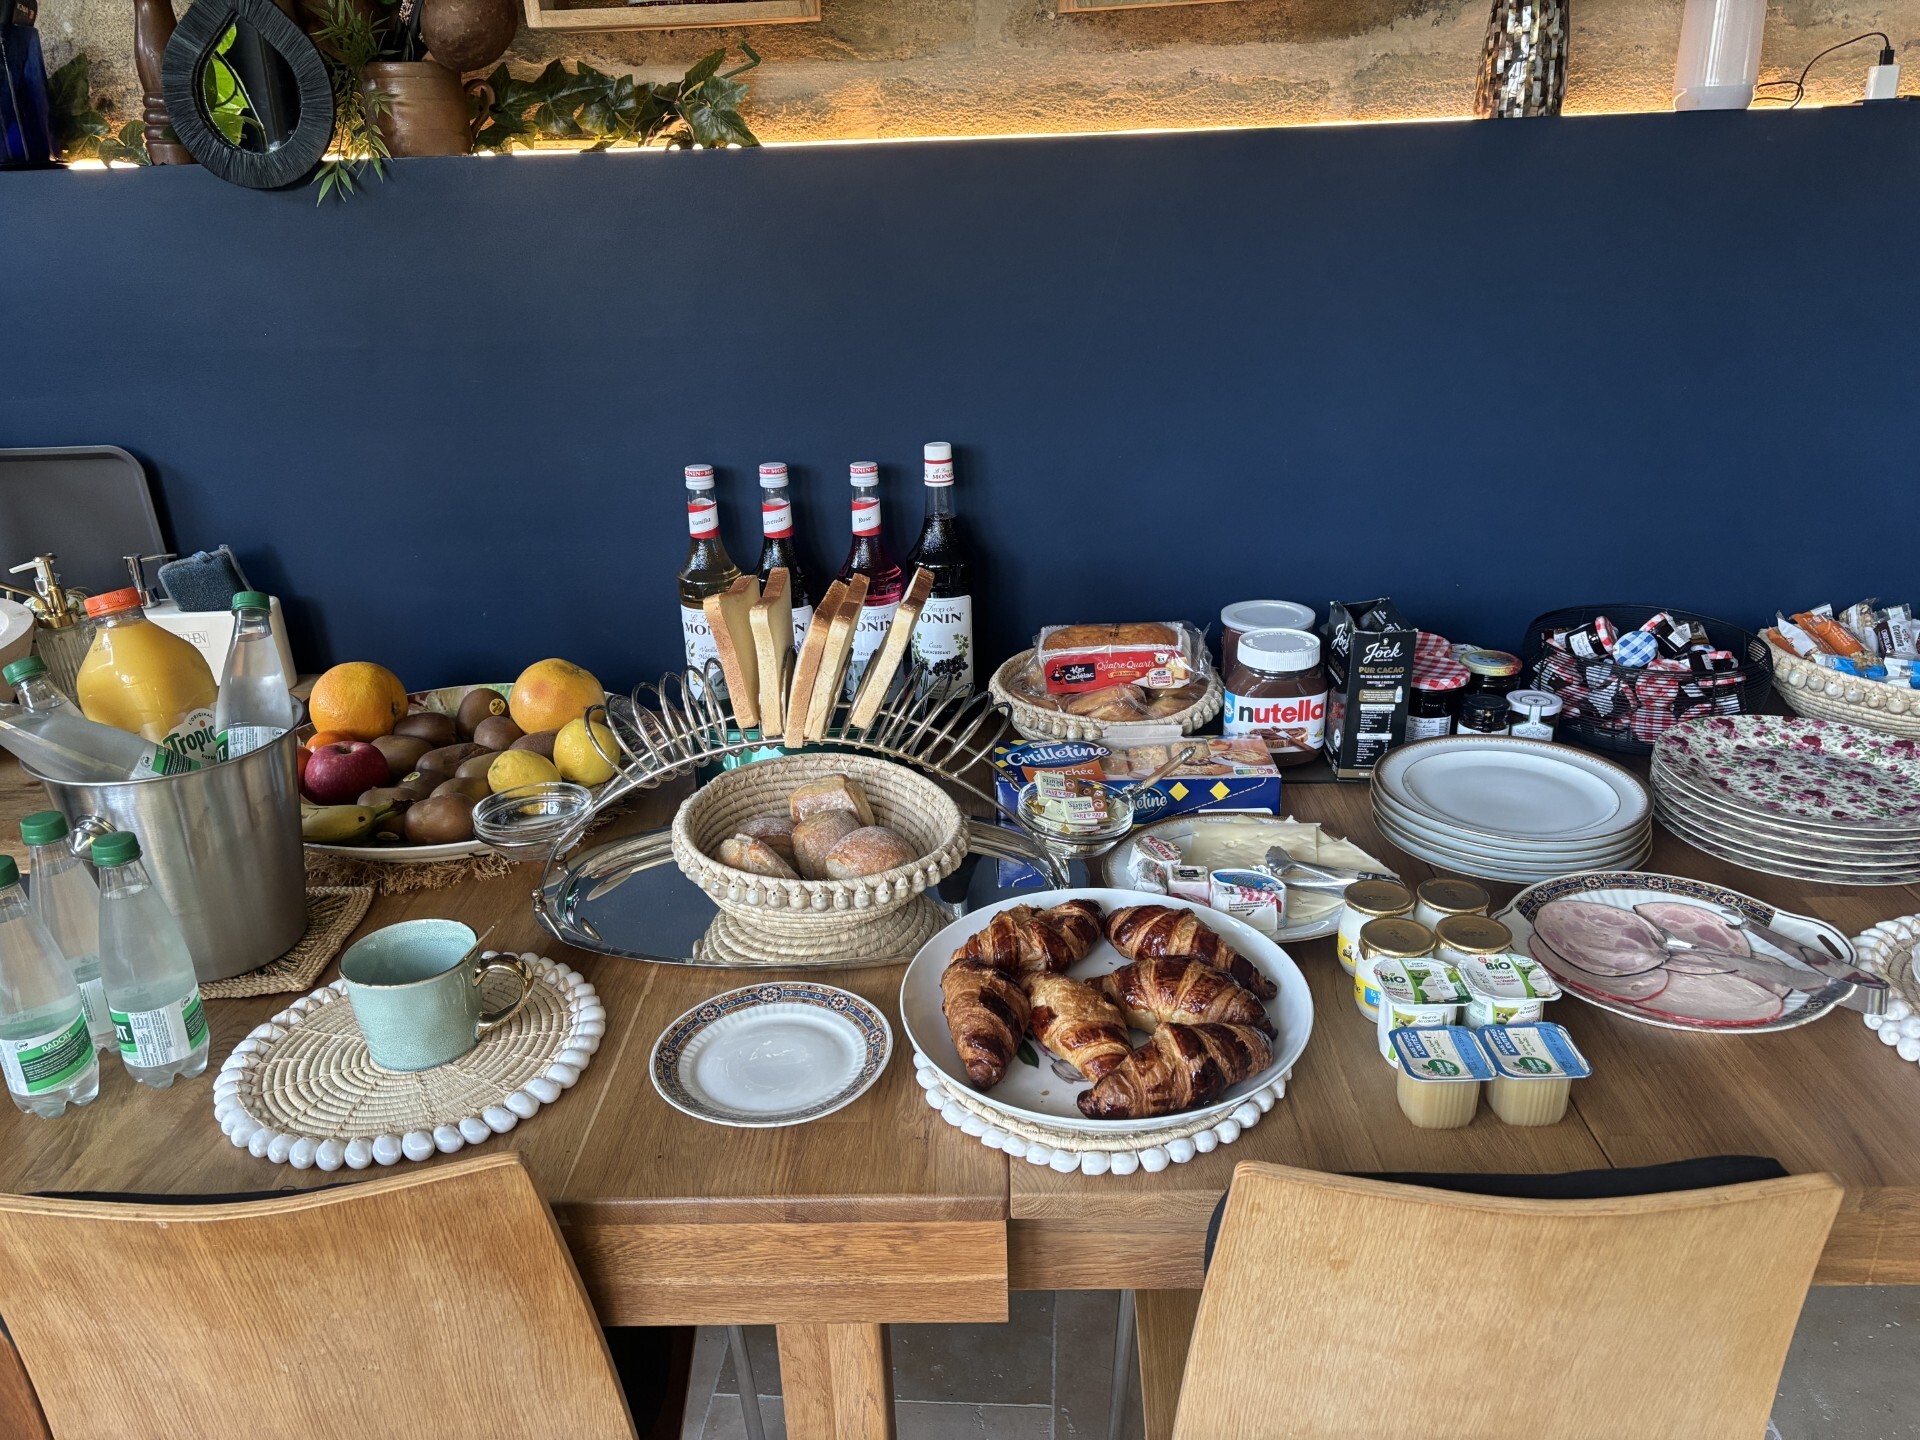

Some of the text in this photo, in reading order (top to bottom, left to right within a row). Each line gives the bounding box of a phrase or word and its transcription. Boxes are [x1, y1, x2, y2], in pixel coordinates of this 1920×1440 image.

[925, 603, 945, 615] Sirop
[861, 611, 880, 621] Sirop
[920, 613, 963, 624] ONIN
[856, 620, 892, 632] ONIN
[1363, 642, 1403, 664] Jock
[1070, 665, 1086, 674] Ker
[1358, 666, 1404, 674] PUR CACAO
[1238, 699, 1324, 723] nutella
[163, 725, 216, 755] Tropic
[1006, 744, 1110, 767] Grilletine
[1035, 768, 1095, 776] iochée
[1132, 794, 1168, 810] letine
